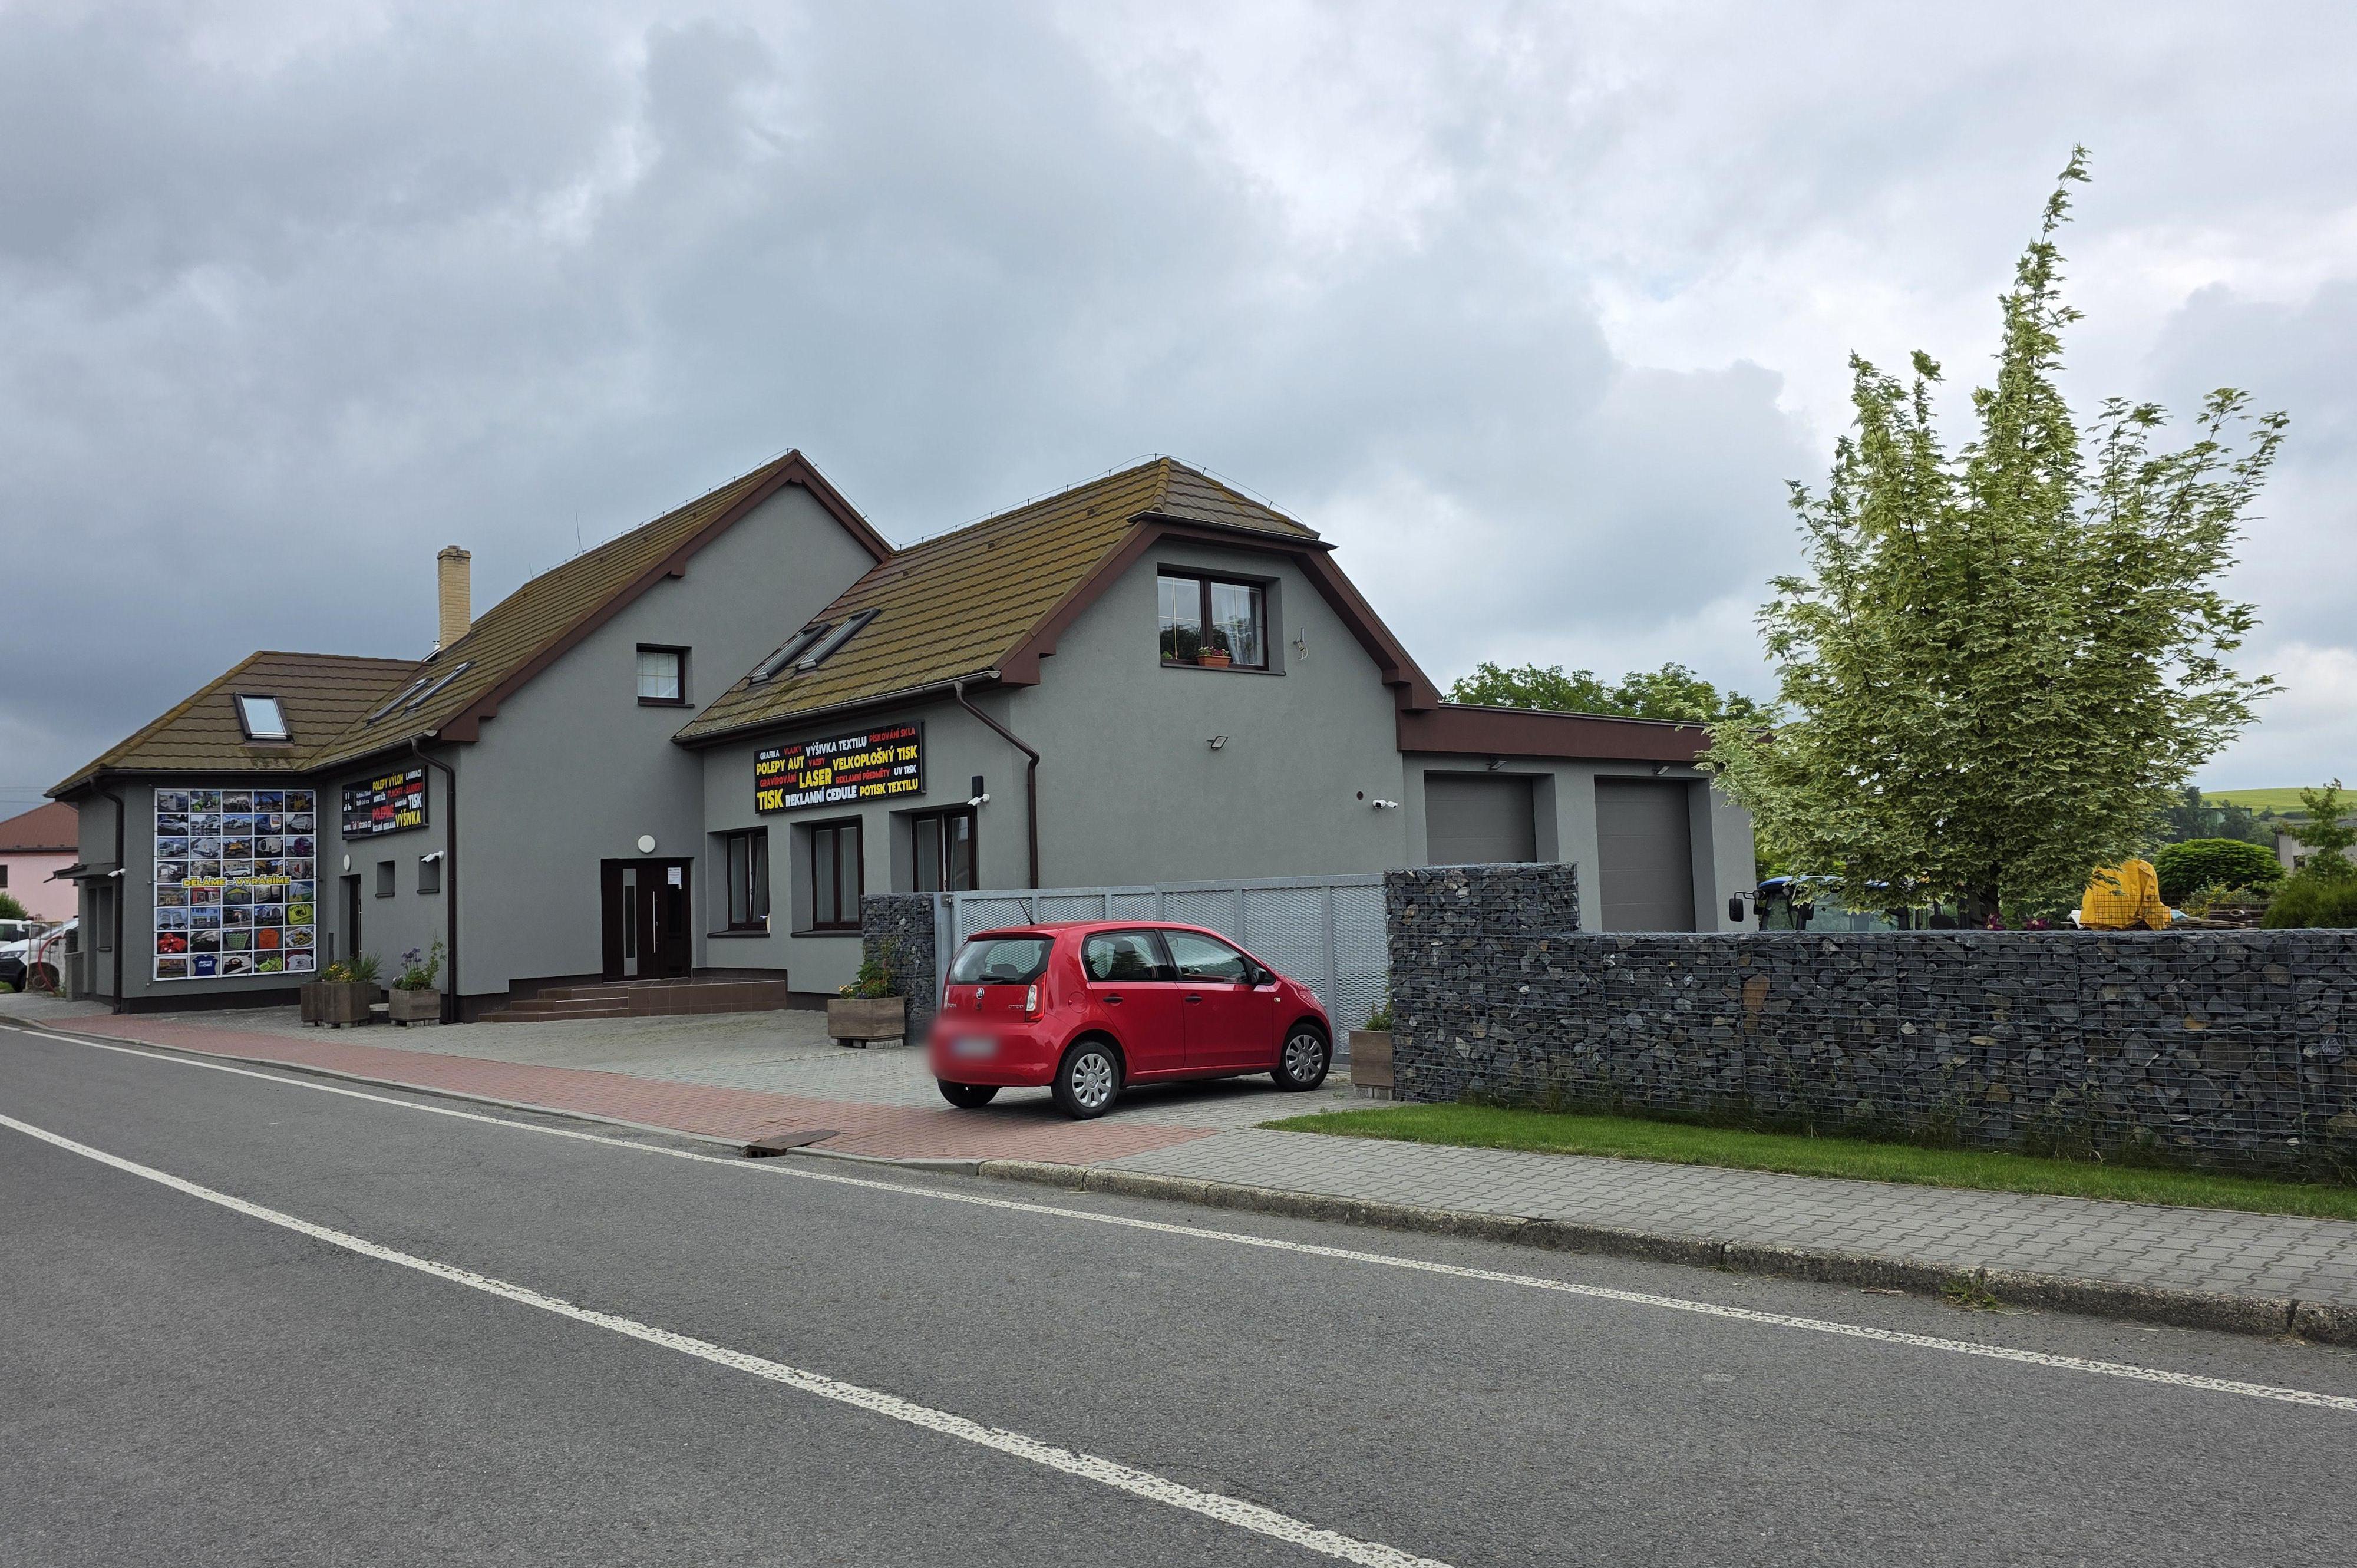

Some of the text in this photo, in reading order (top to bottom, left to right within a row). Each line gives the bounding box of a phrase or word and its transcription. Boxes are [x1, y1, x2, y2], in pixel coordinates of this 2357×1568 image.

[869, 727, 915, 743] PÍSKOVÁNÍ SKLA
[760, 750, 780, 760] GRAFIKA
[805, 736, 867, 757] VÝŠIVKA TEXTILU
[756, 755, 804, 775] POLEPY AUT
[833, 745, 917, 771] VELKOPLOŠNÝ TISK
[799, 768, 832, 788] LASER
[836, 768, 890, 784] REKLAMNÍ PŘEDMĚTY
[894, 764, 916, 776] UV TISK
[372, 773, 403, 791] POLEPY VÝLOH
[760, 772, 797, 788] GRAVÍROVÁNÍ
[860, 778, 919, 797] POTISK TEXTILU
[408, 793, 422, 810] TISK
[757, 788, 784, 810] TISK
[785, 785, 857, 807] REKLAMNÍ CEDULE
[395, 808, 421, 828] VÝŠIVKA
[183, 876, 225, 886] DĚLÁME
[235, 874, 290, 886] VYRÁBÍME
